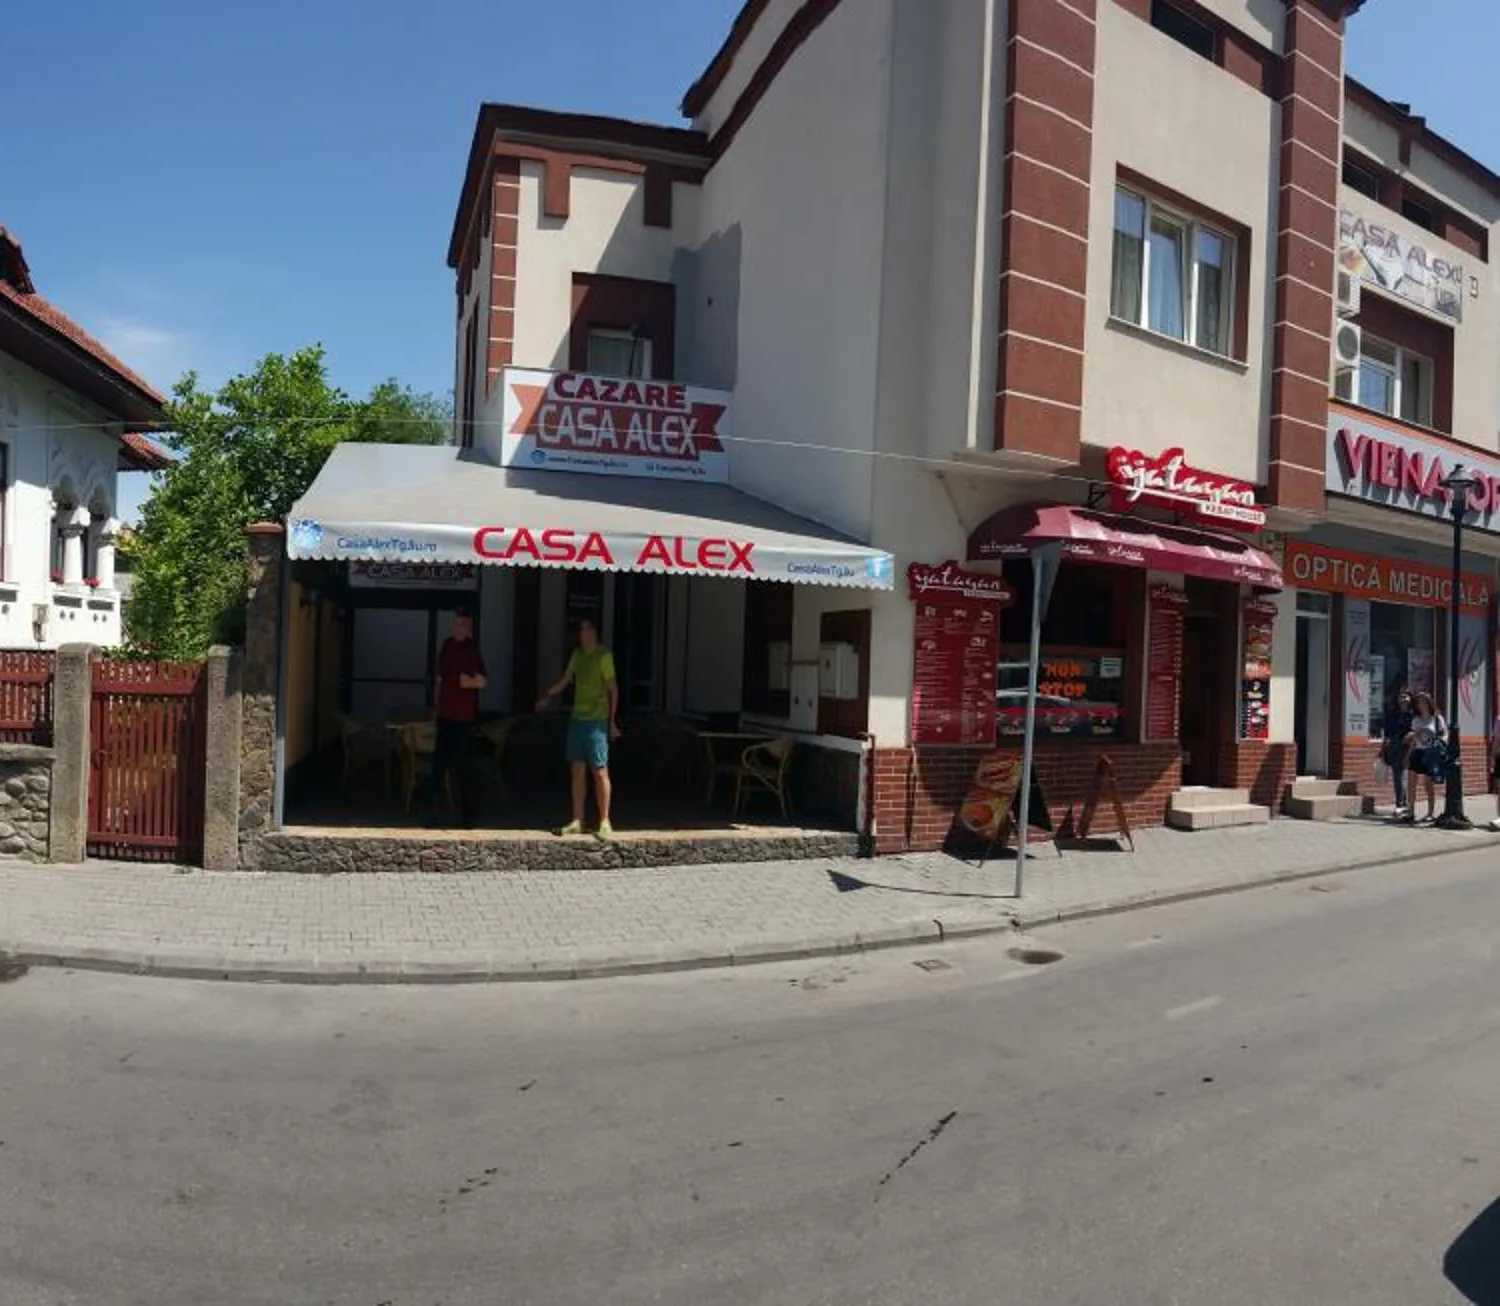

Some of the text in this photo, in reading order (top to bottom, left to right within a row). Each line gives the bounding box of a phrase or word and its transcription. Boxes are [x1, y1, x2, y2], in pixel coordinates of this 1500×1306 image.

[553, 373, 687, 409] CAZARE
[538, 403, 698, 456] CASA ALEX
[1339, 427, 1453, 502] VIENA
[473, 526, 756, 573] CASA ALEX
